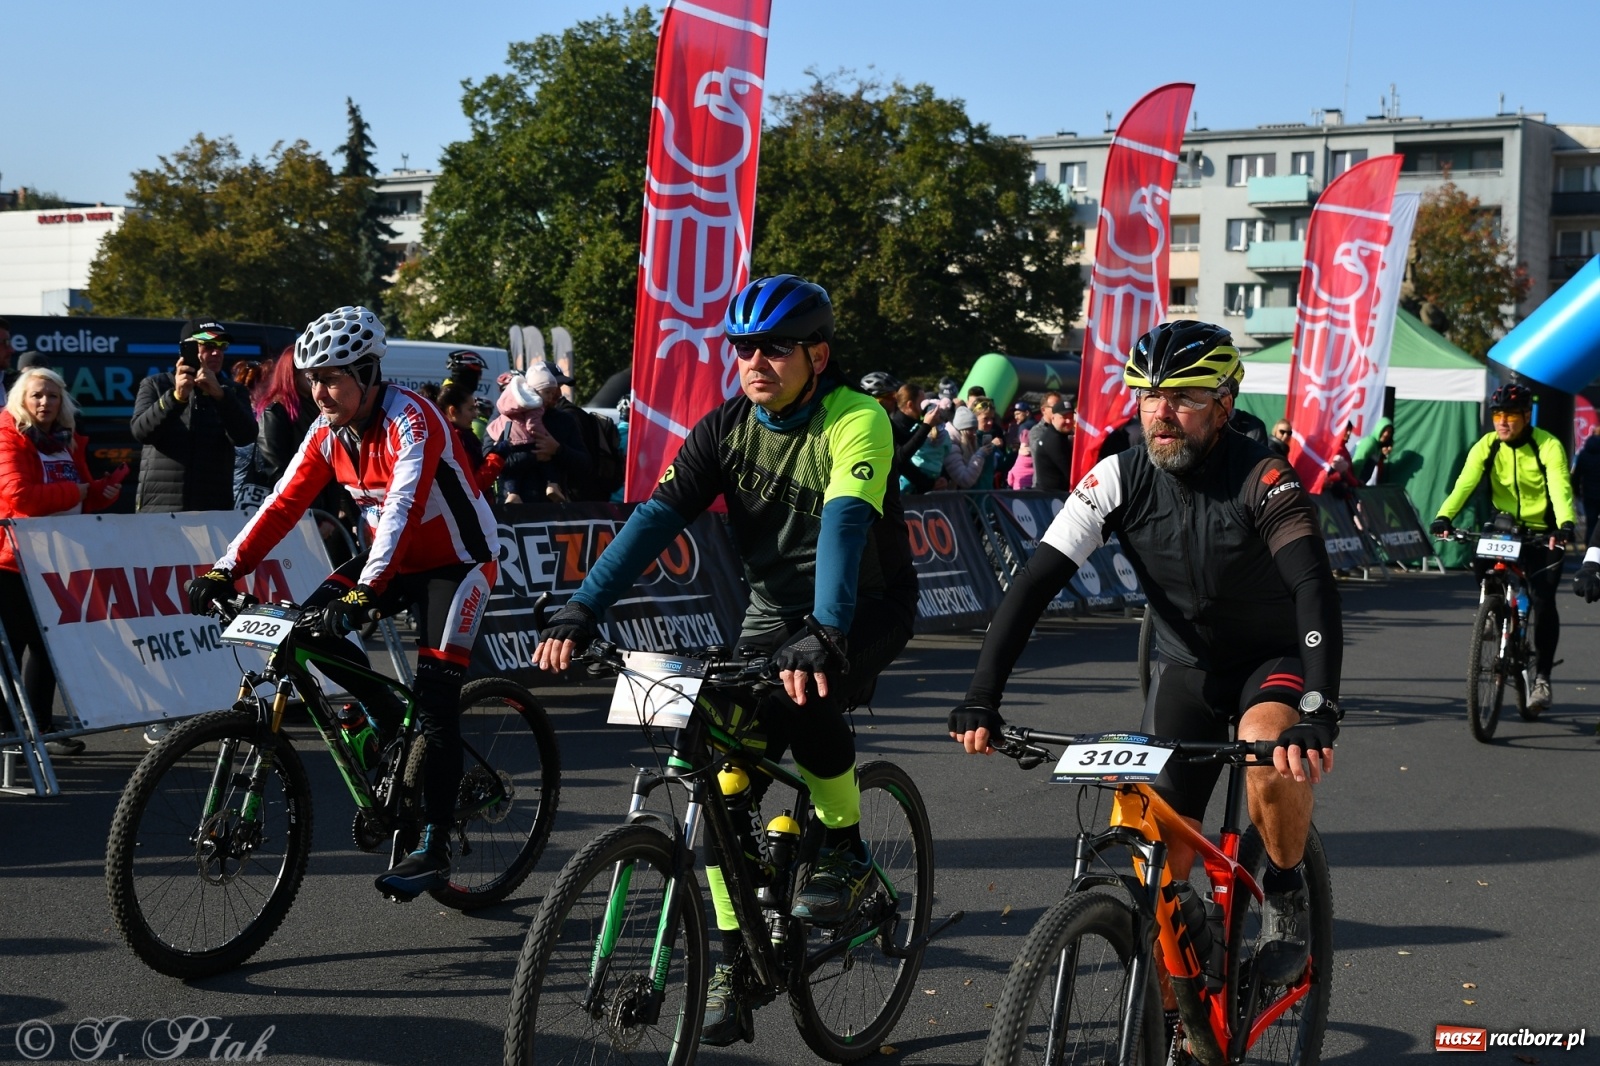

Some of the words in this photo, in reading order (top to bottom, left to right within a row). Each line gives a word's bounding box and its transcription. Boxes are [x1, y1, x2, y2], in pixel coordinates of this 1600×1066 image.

[35, 329, 120, 353] atelier
[1073, 488, 1098, 511] REK
[1325, 536, 1363, 553] ERIDA
[1486, 543, 1514, 553] 3193
[237, 620, 281, 637] 3028
[616, 612, 725, 651] NAJLEPSZYCH
[132, 630, 191, 665] TAKE
[1078, 750, 1149, 766] 3101
